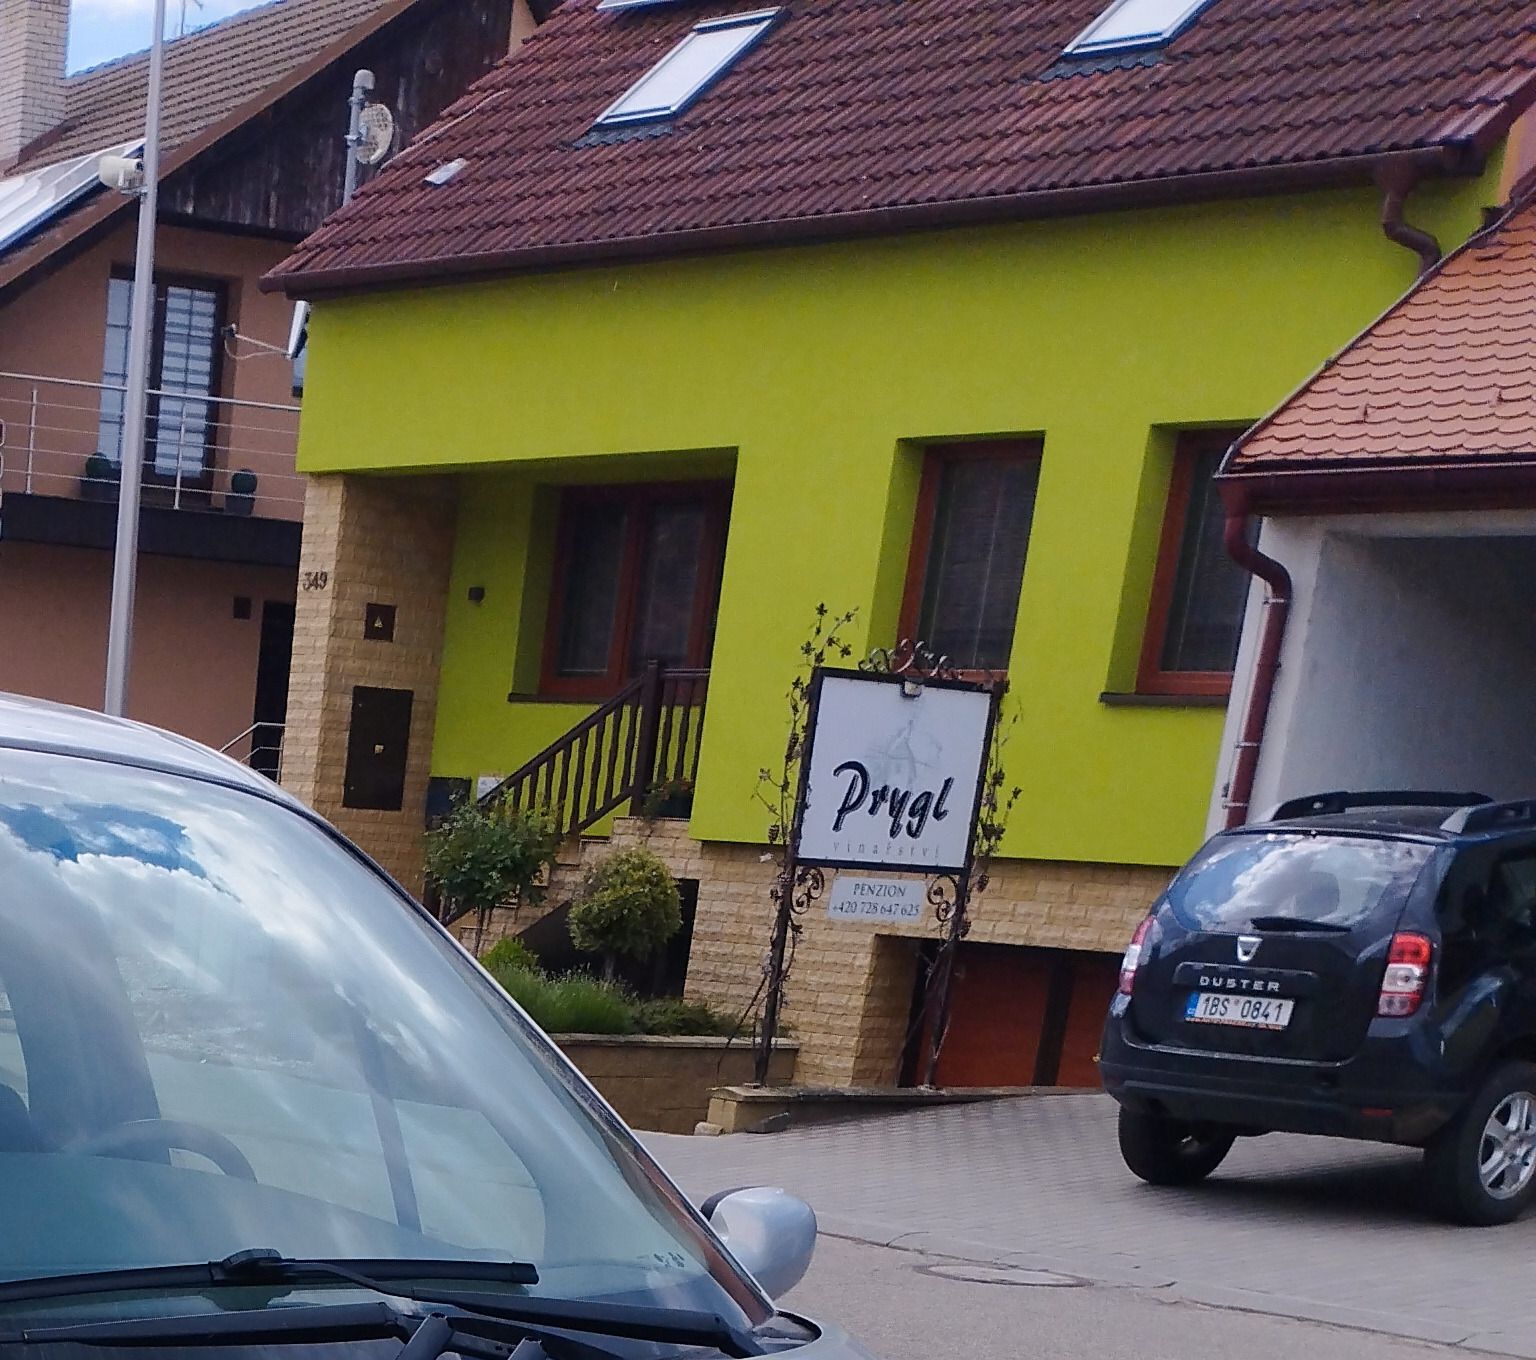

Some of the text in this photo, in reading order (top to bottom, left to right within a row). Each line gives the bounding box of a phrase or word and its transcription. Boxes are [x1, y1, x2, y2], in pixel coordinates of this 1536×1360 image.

[302, 571, 328, 590] 349
[833, 760, 955, 839] Prygl
[853, 883, 906, 898] PENZION
[832, 901, 858, 914] +420
[1199, 976, 1280, 992] DUSTER
[1203, 996, 1284, 1022] 1BS 0841
